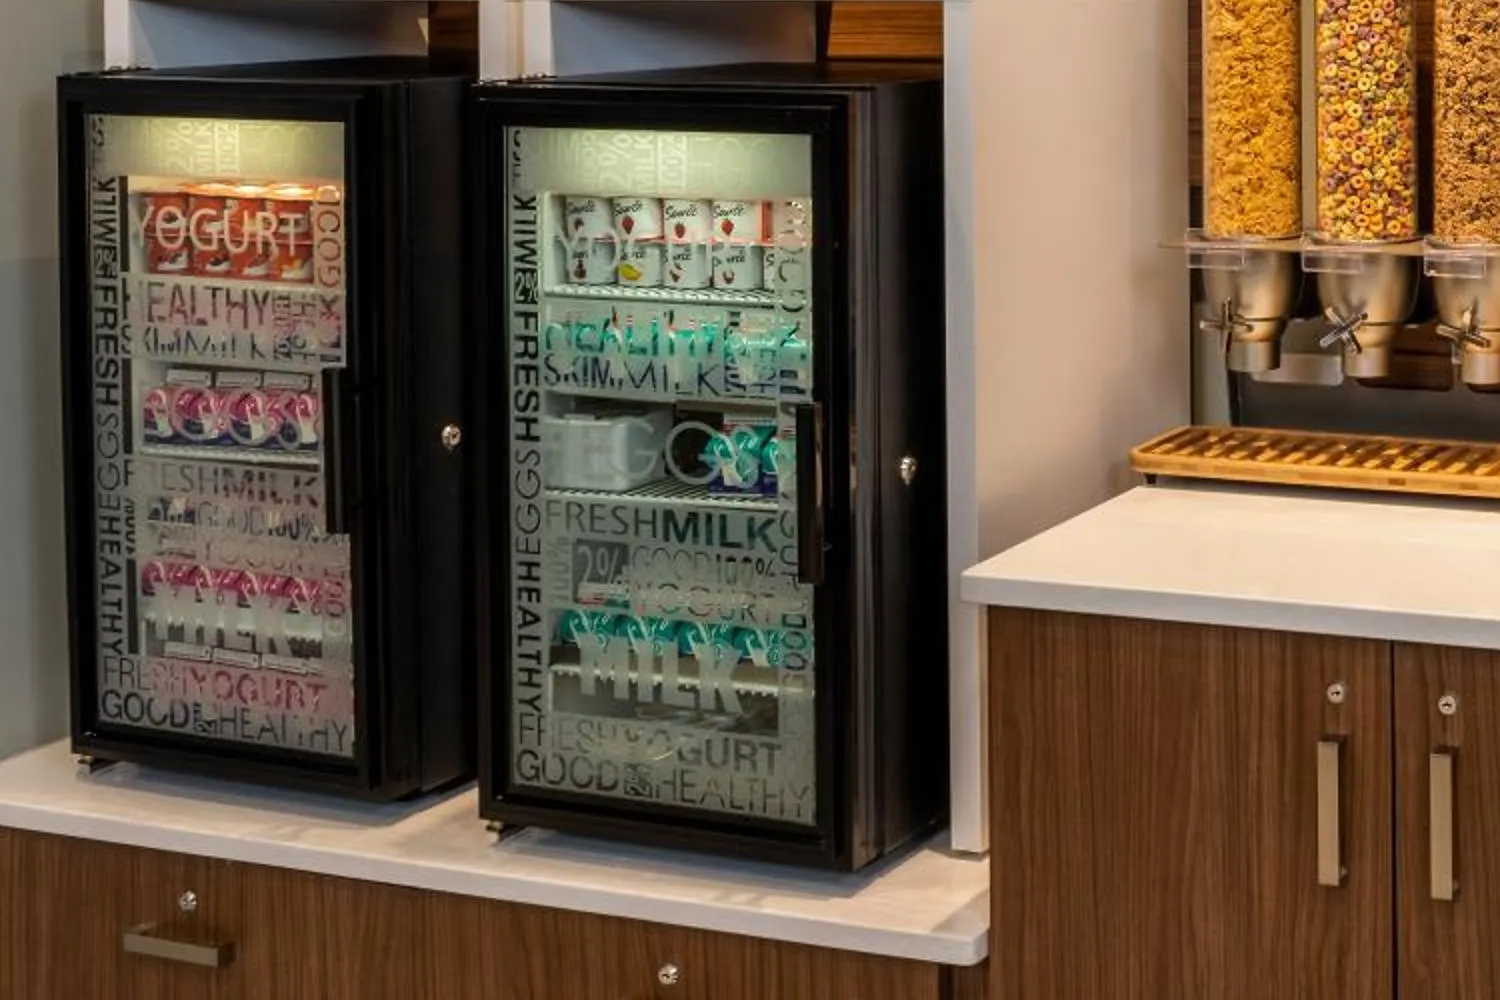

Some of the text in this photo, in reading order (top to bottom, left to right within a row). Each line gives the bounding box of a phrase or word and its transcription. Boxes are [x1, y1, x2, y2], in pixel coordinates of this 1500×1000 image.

[136, 202, 304, 262] YOGURT
[513, 194, 538, 266] MILK
[94, 284, 119, 407] FRESH
[514, 310, 541, 443] FRESH
[514, 448, 543, 556] EGGS
[661, 509, 779, 553] MILK
[99, 515, 124, 656] HEALTHY
[515, 560, 544, 713] HEALTHY
